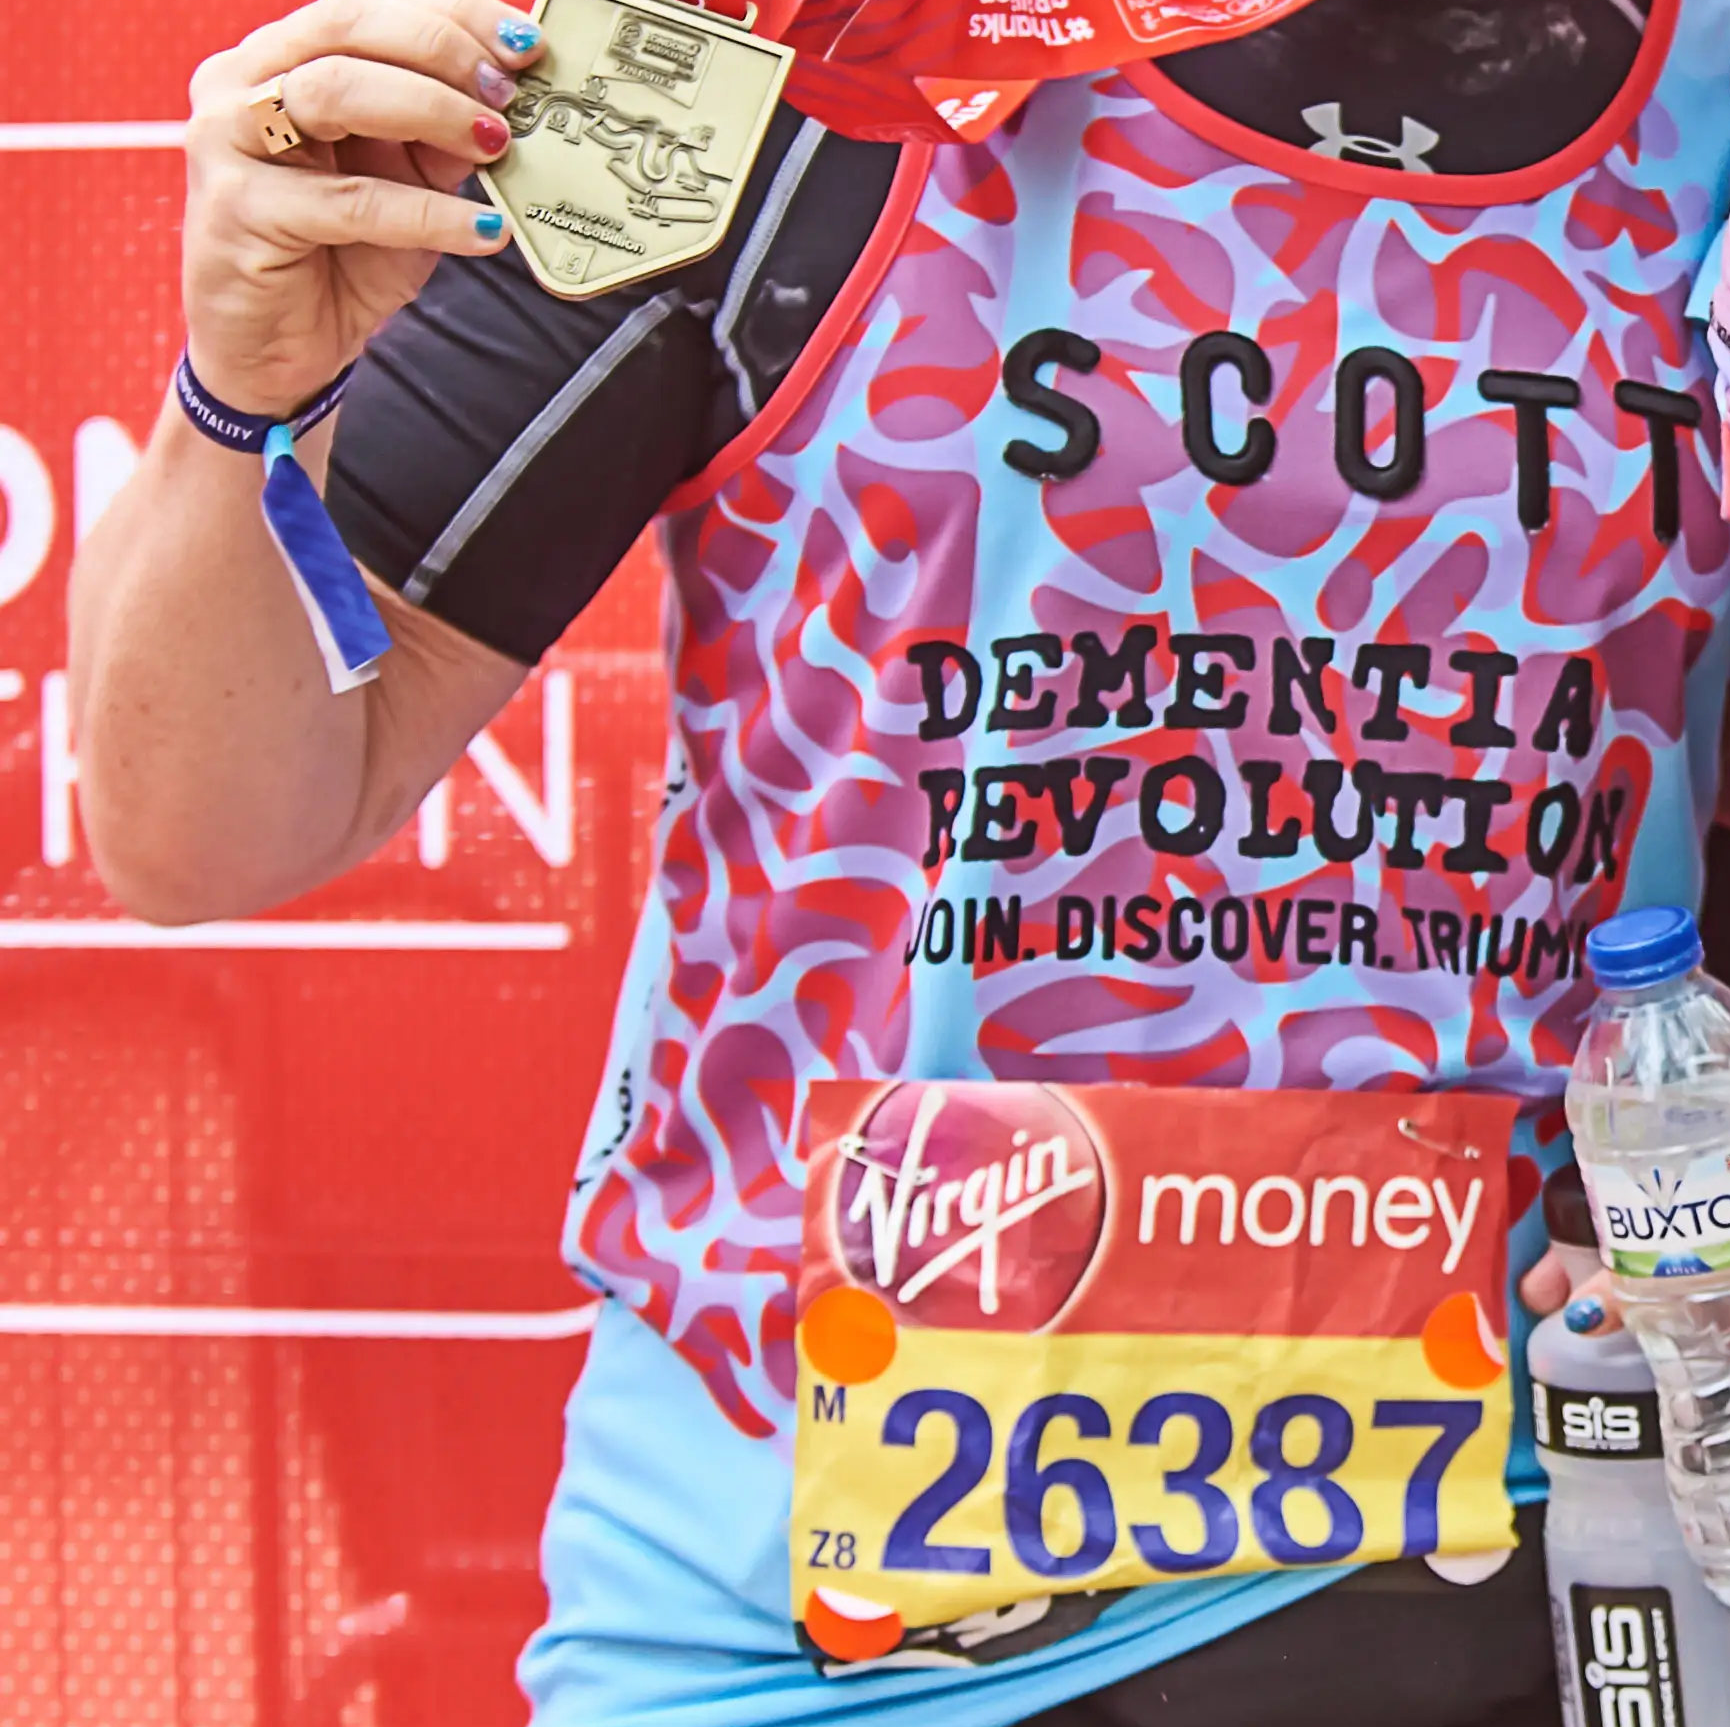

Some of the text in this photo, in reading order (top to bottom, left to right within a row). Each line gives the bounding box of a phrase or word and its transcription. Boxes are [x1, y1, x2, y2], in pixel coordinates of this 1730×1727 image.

[968, 13, 1096, 47] #Thanks
[1003, 327, 1702, 543] SCOTT
[907, 625, 1595, 758] DEMENTIA
[918, 755, 1626, 885] REVOLUTION
[904, 894, 1037, 966] JOIN.
[1056, 895, 1395, 970] DISCOVER.
[848, 1086, 1484, 1315] Virgin money
[812, 1385, 847, 1424] M
[879, 1387, 1485, 1579] 26387
[808, 1530, 858, 1572] Z8
